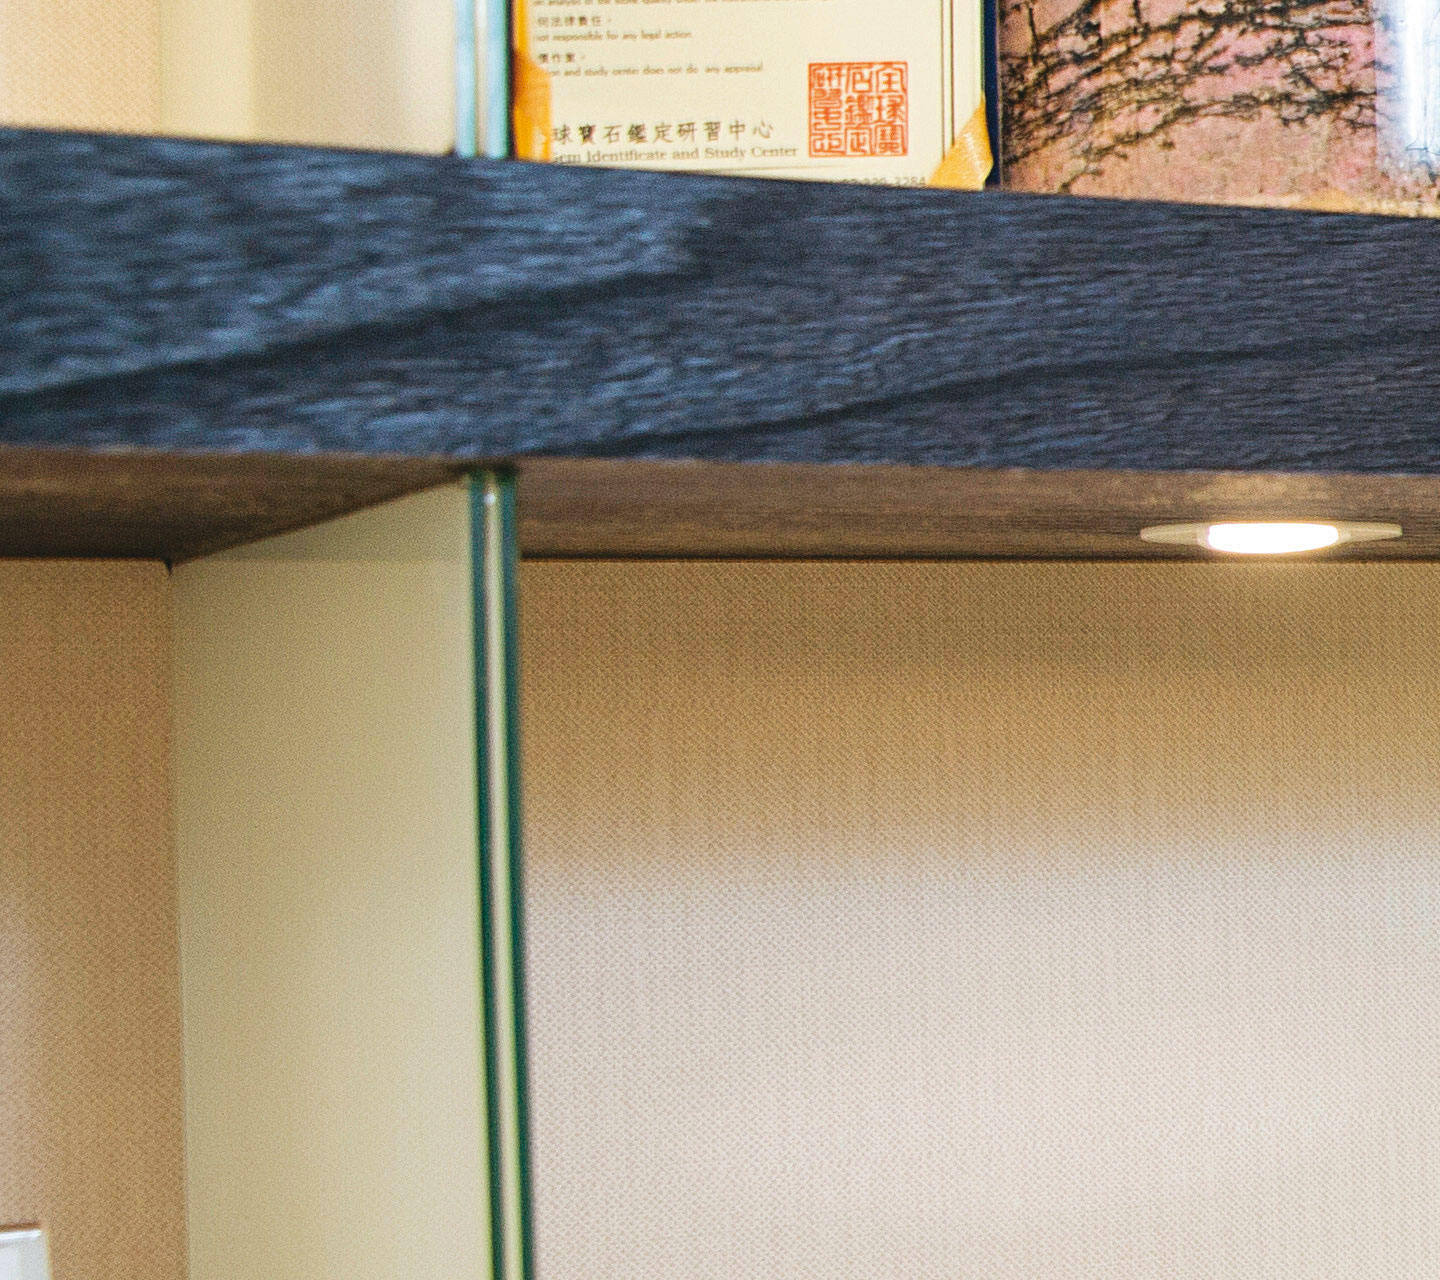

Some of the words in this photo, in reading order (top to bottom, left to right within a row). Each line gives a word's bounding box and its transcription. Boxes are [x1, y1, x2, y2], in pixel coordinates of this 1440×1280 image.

[672, 147, 700, 161] and
[704, 147, 747, 162] Study
[750, 144, 800, 158] Center
